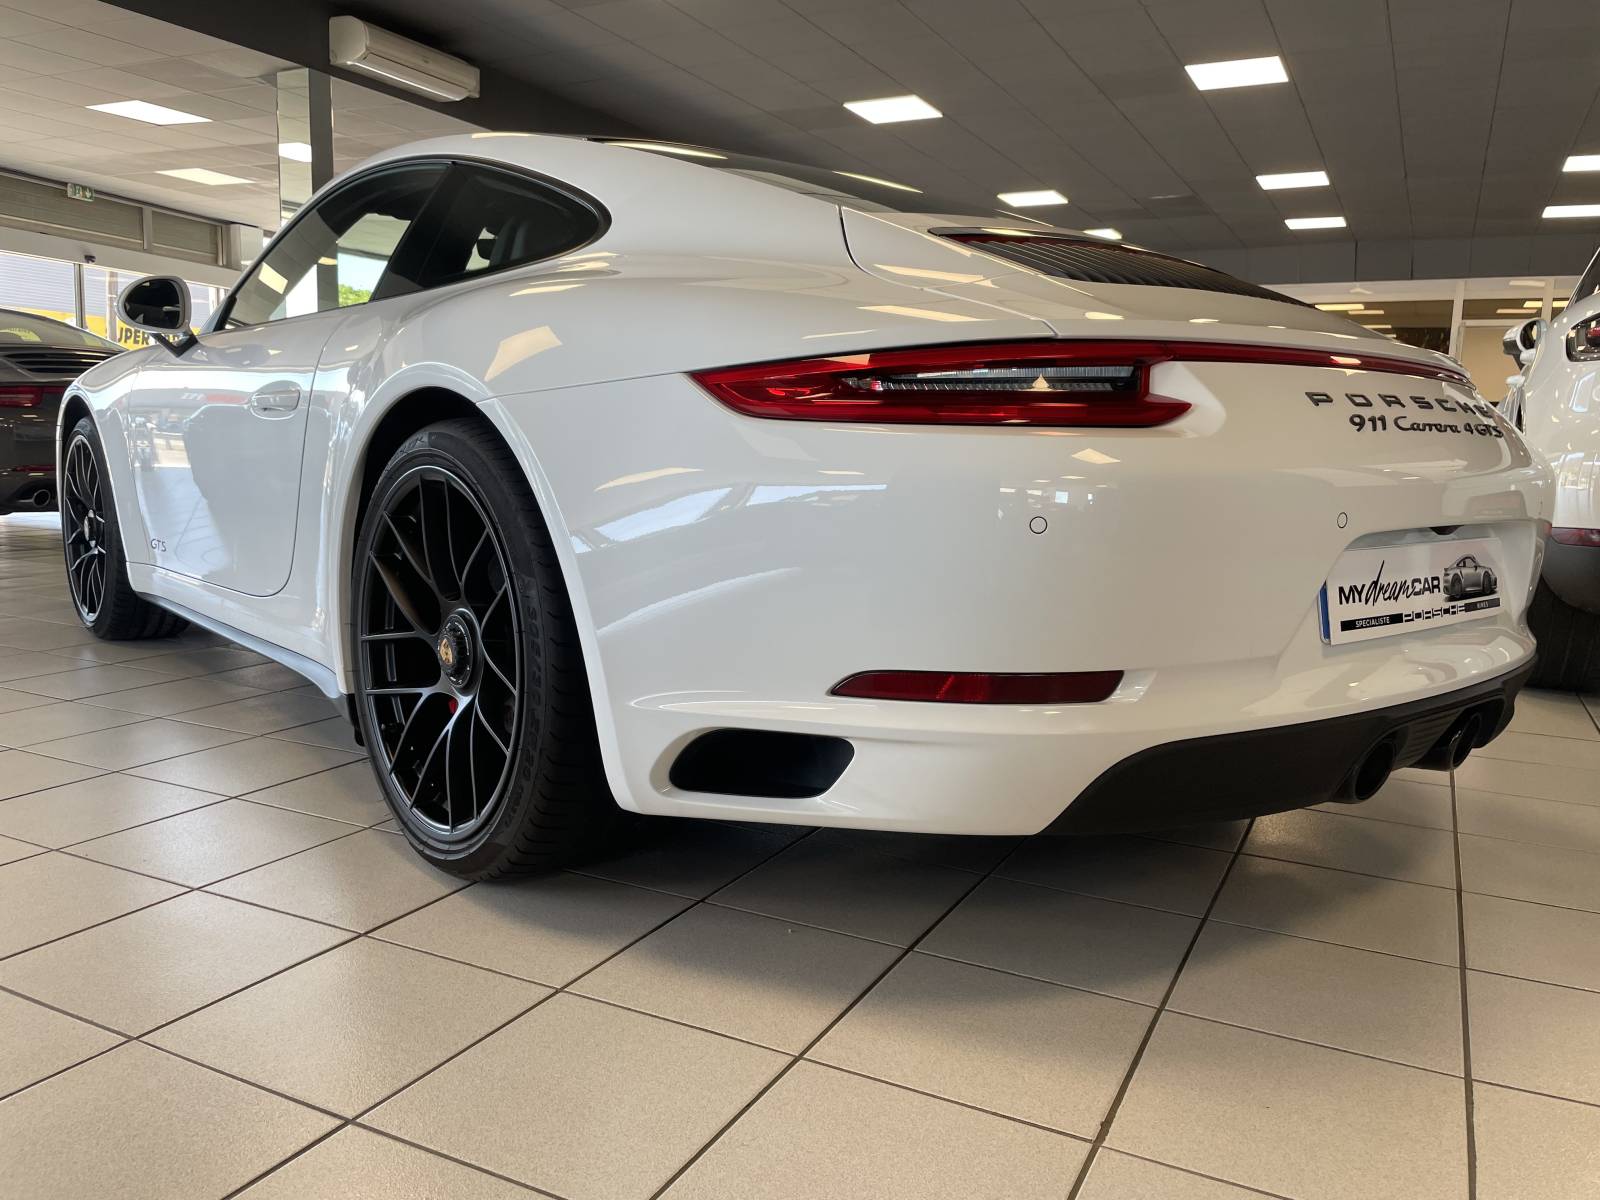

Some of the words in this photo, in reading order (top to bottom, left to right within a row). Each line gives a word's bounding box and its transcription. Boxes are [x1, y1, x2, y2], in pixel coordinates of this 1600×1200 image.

[1305, 391, 1495, 419] PORSCHE
[1349, 414, 1387, 432] 911
[1393, 416, 1461, 434] Carrera
[150, 538, 167, 552] GTS
[1355, 616, 1390, 628] SPECIALISTE
[1403, 603, 1466, 623] PORSCHE
